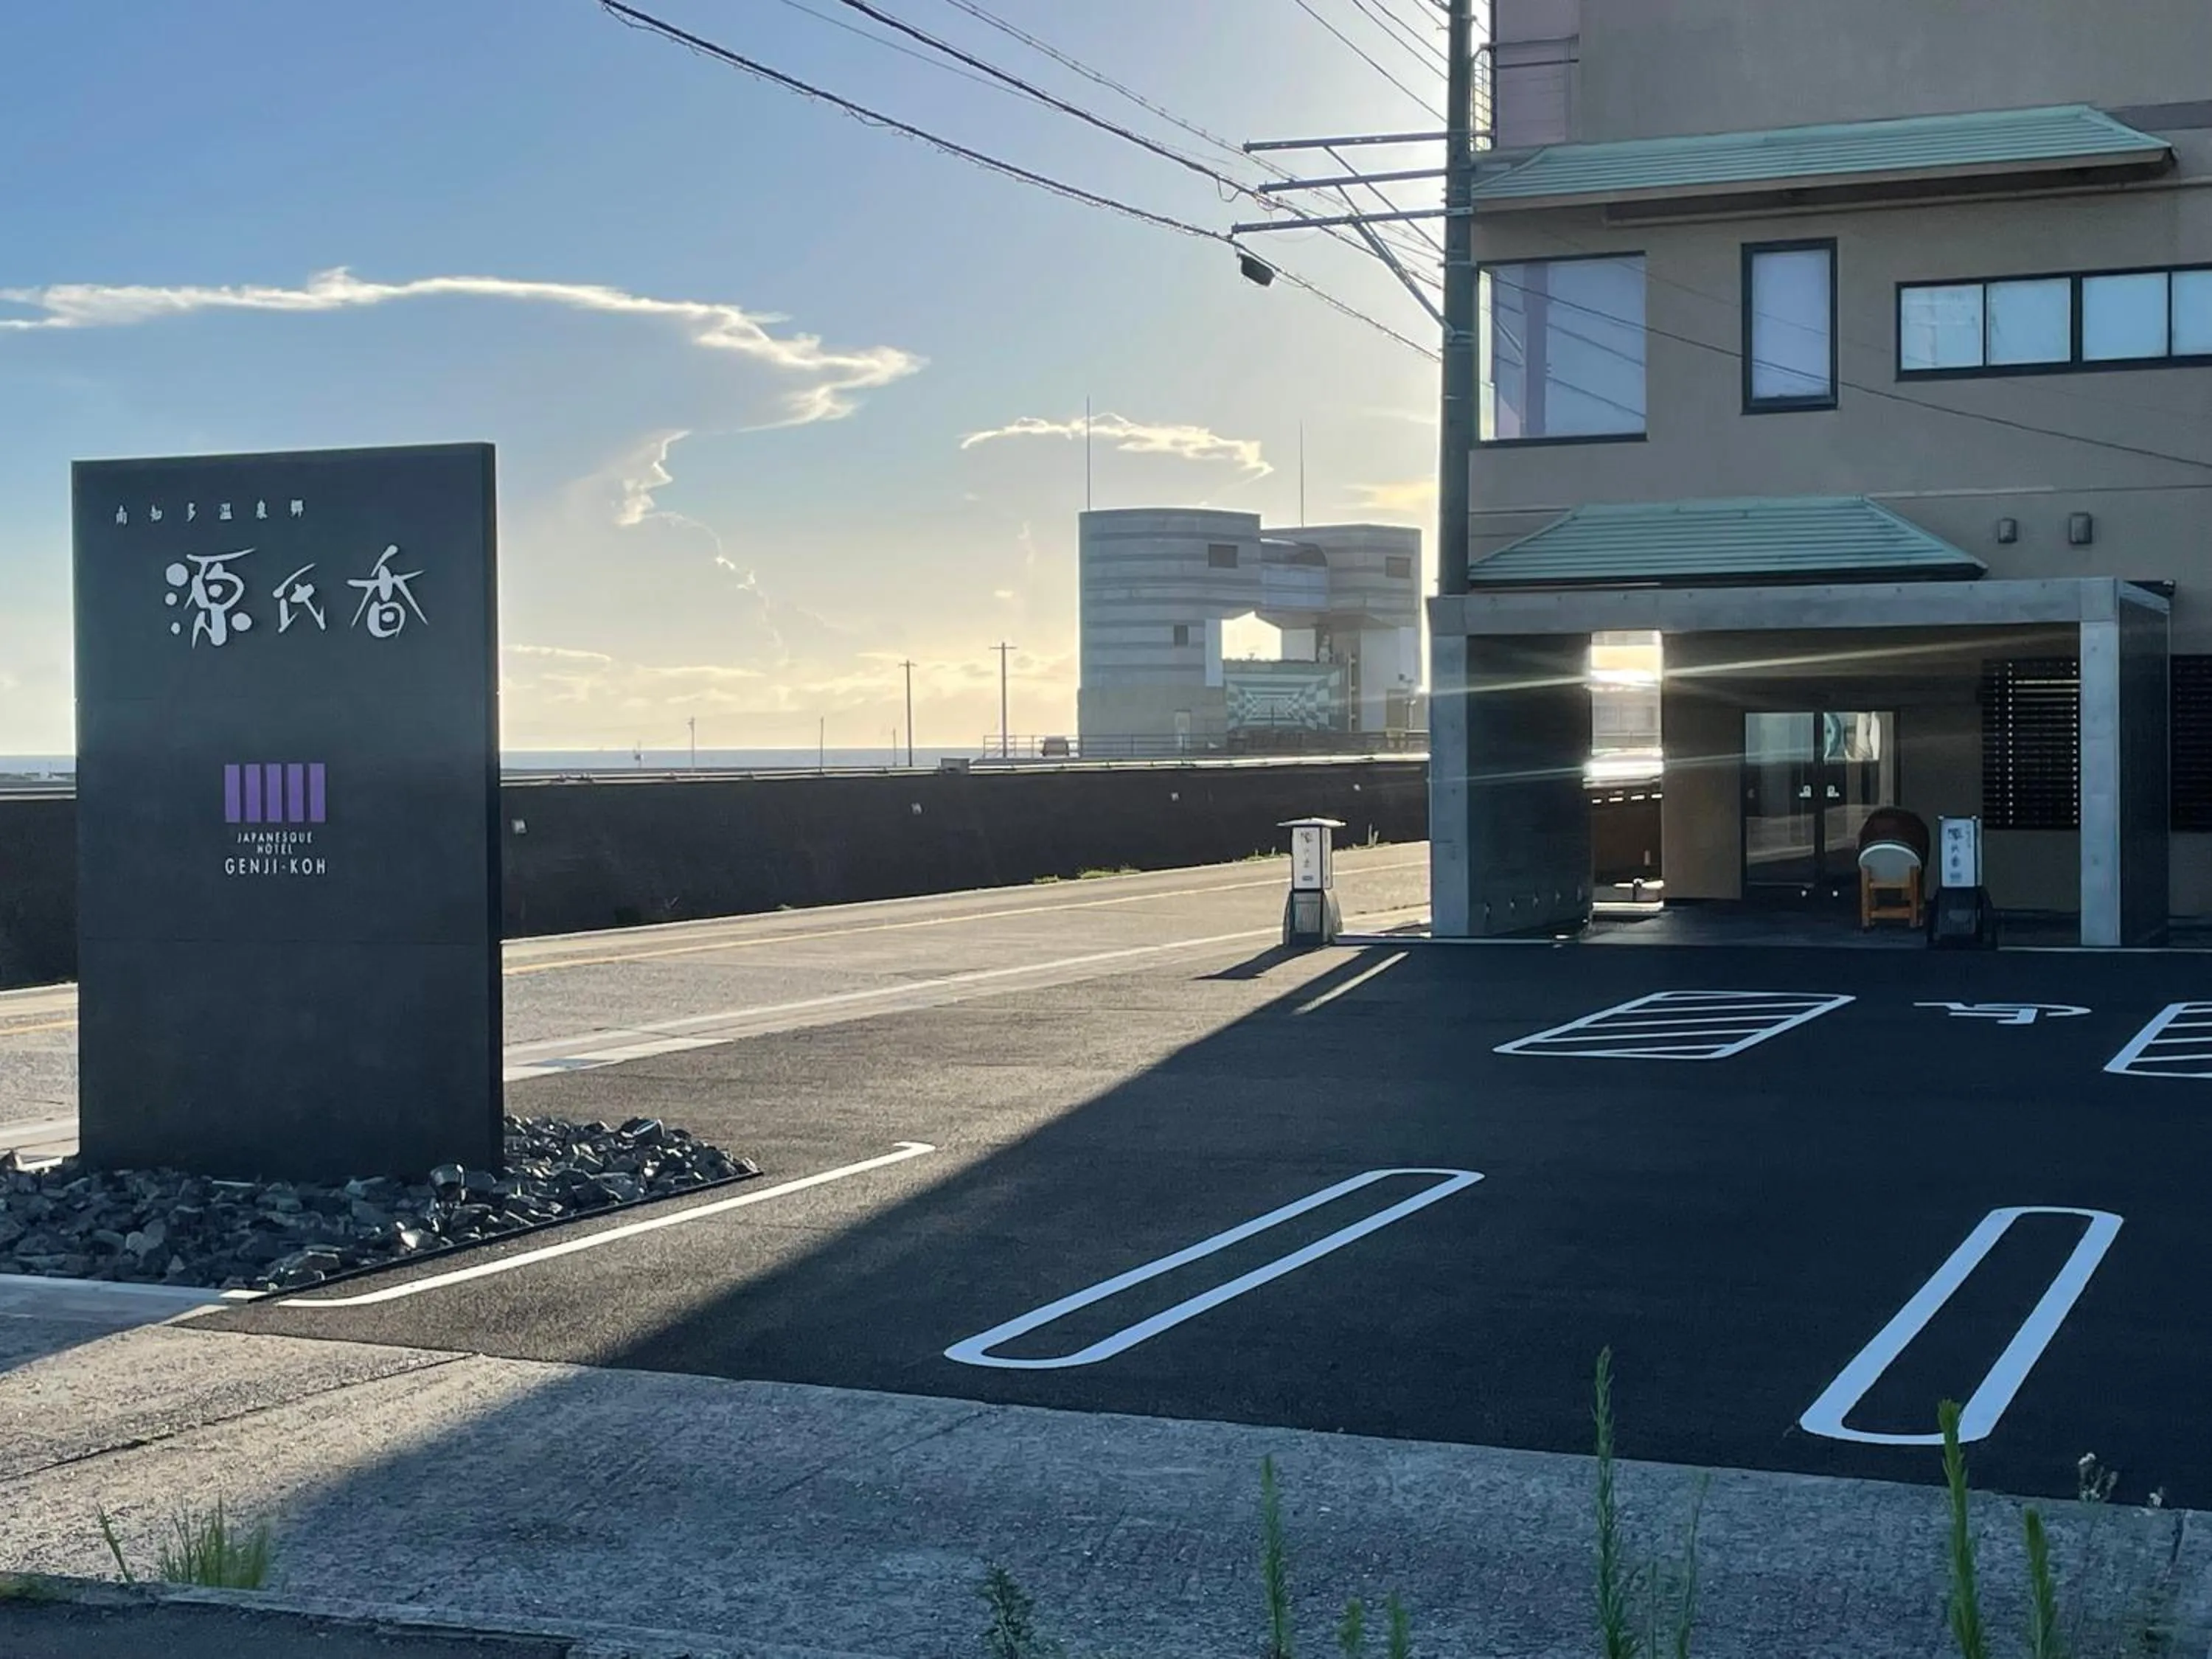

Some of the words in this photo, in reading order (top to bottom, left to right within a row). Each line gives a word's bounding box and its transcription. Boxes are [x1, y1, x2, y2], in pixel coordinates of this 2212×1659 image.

[164, 544, 429, 649] 源氏香
[237, 831, 313, 844] JAPANESQUE
[257, 843, 293, 855] HOTEL
[225, 858, 326, 875] GENJI-KOH
